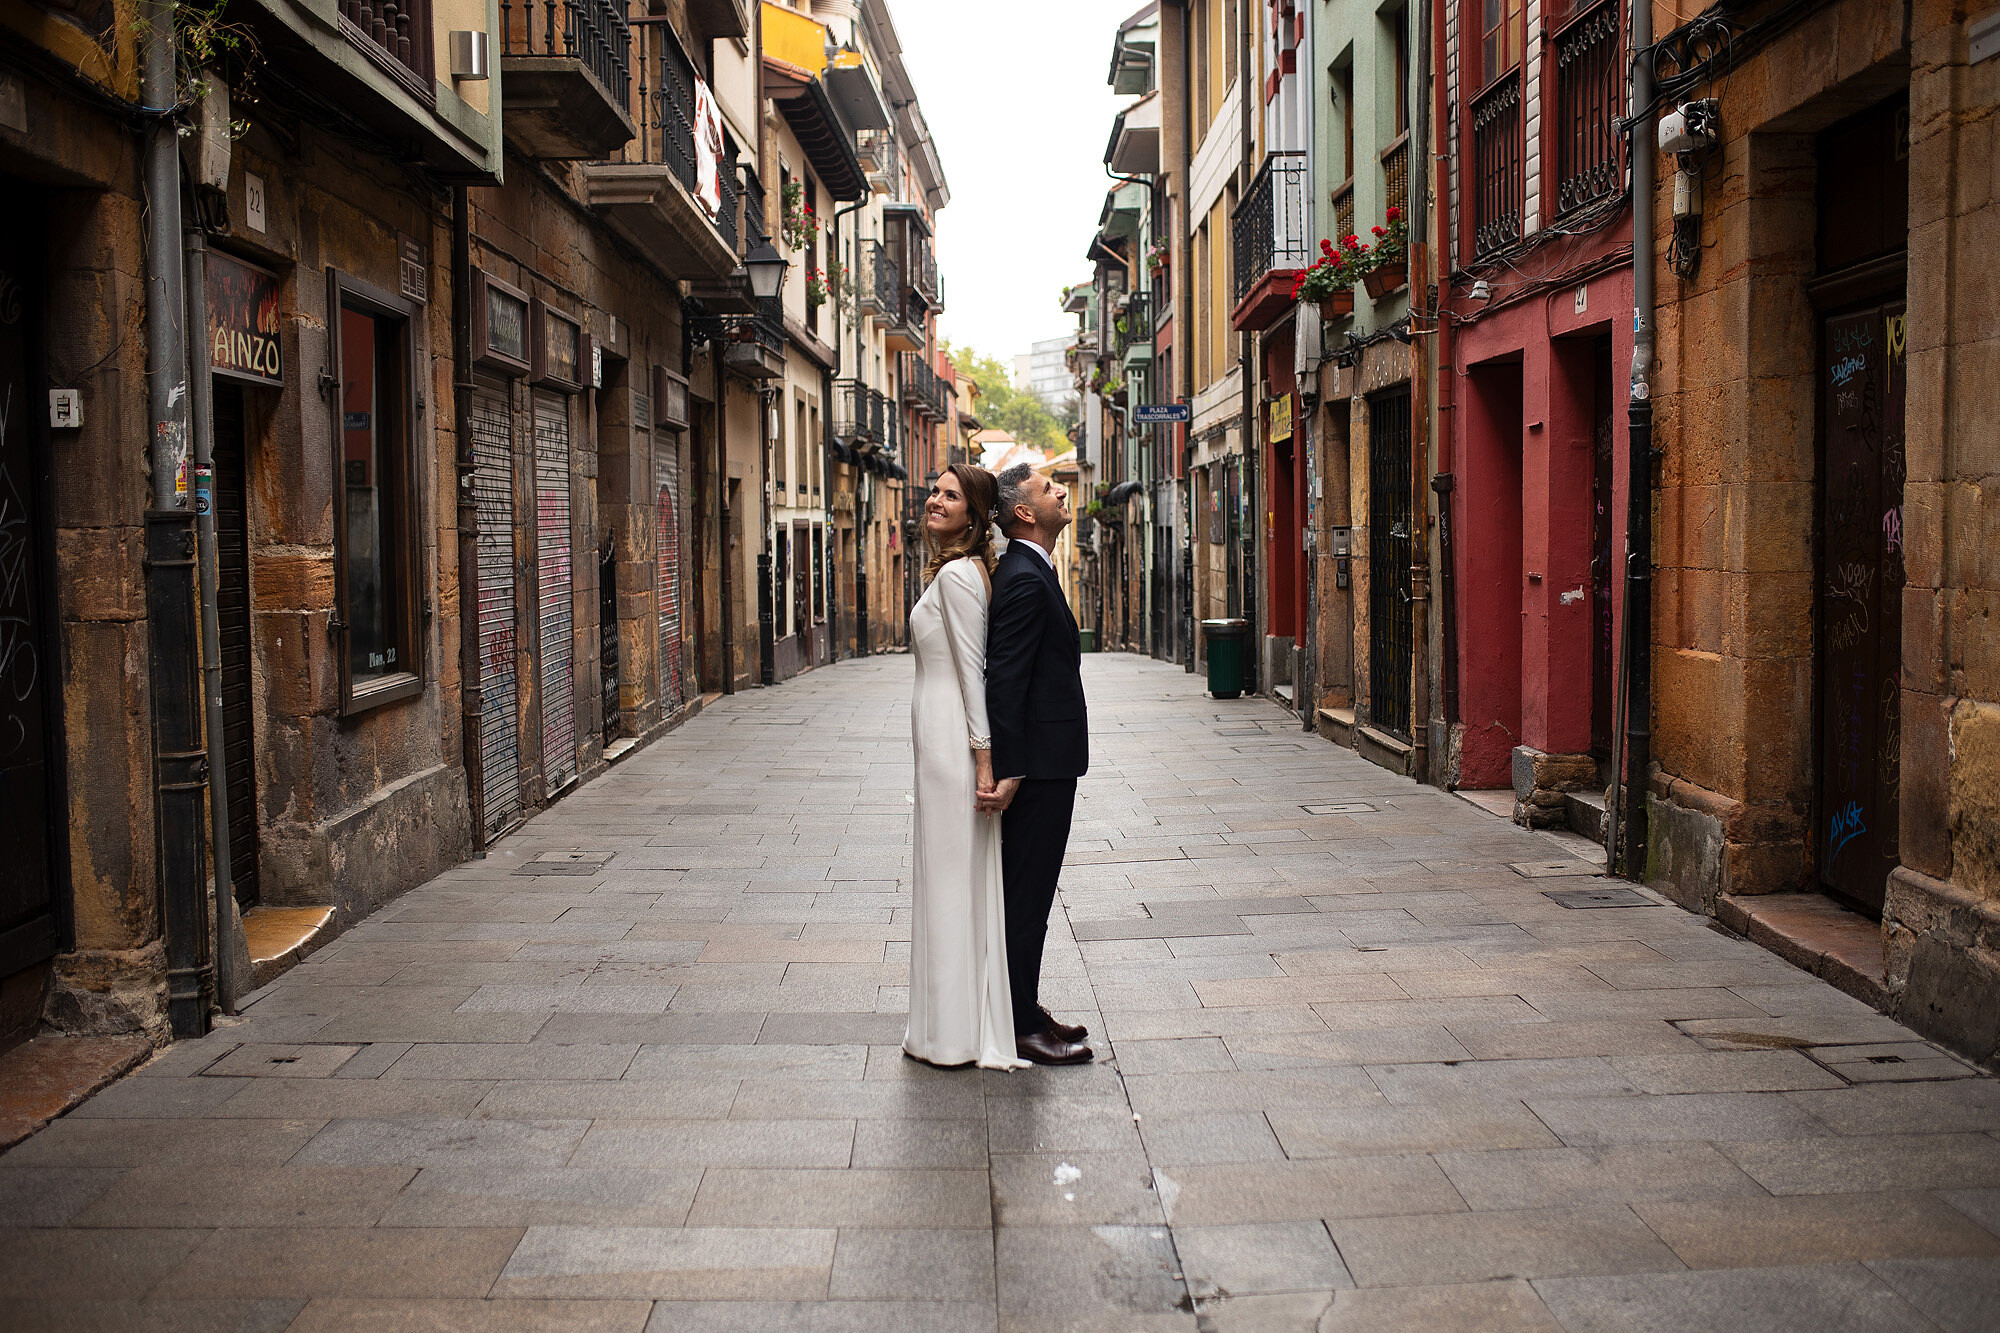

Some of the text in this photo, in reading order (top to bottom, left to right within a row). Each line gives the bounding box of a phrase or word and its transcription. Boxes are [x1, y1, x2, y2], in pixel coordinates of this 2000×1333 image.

[249, 186, 261, 213] 22
[1576, 285, 1586, 306] 27
[209, 326, 280, 375] AINZO
[387, 647, 396, 664] 22
